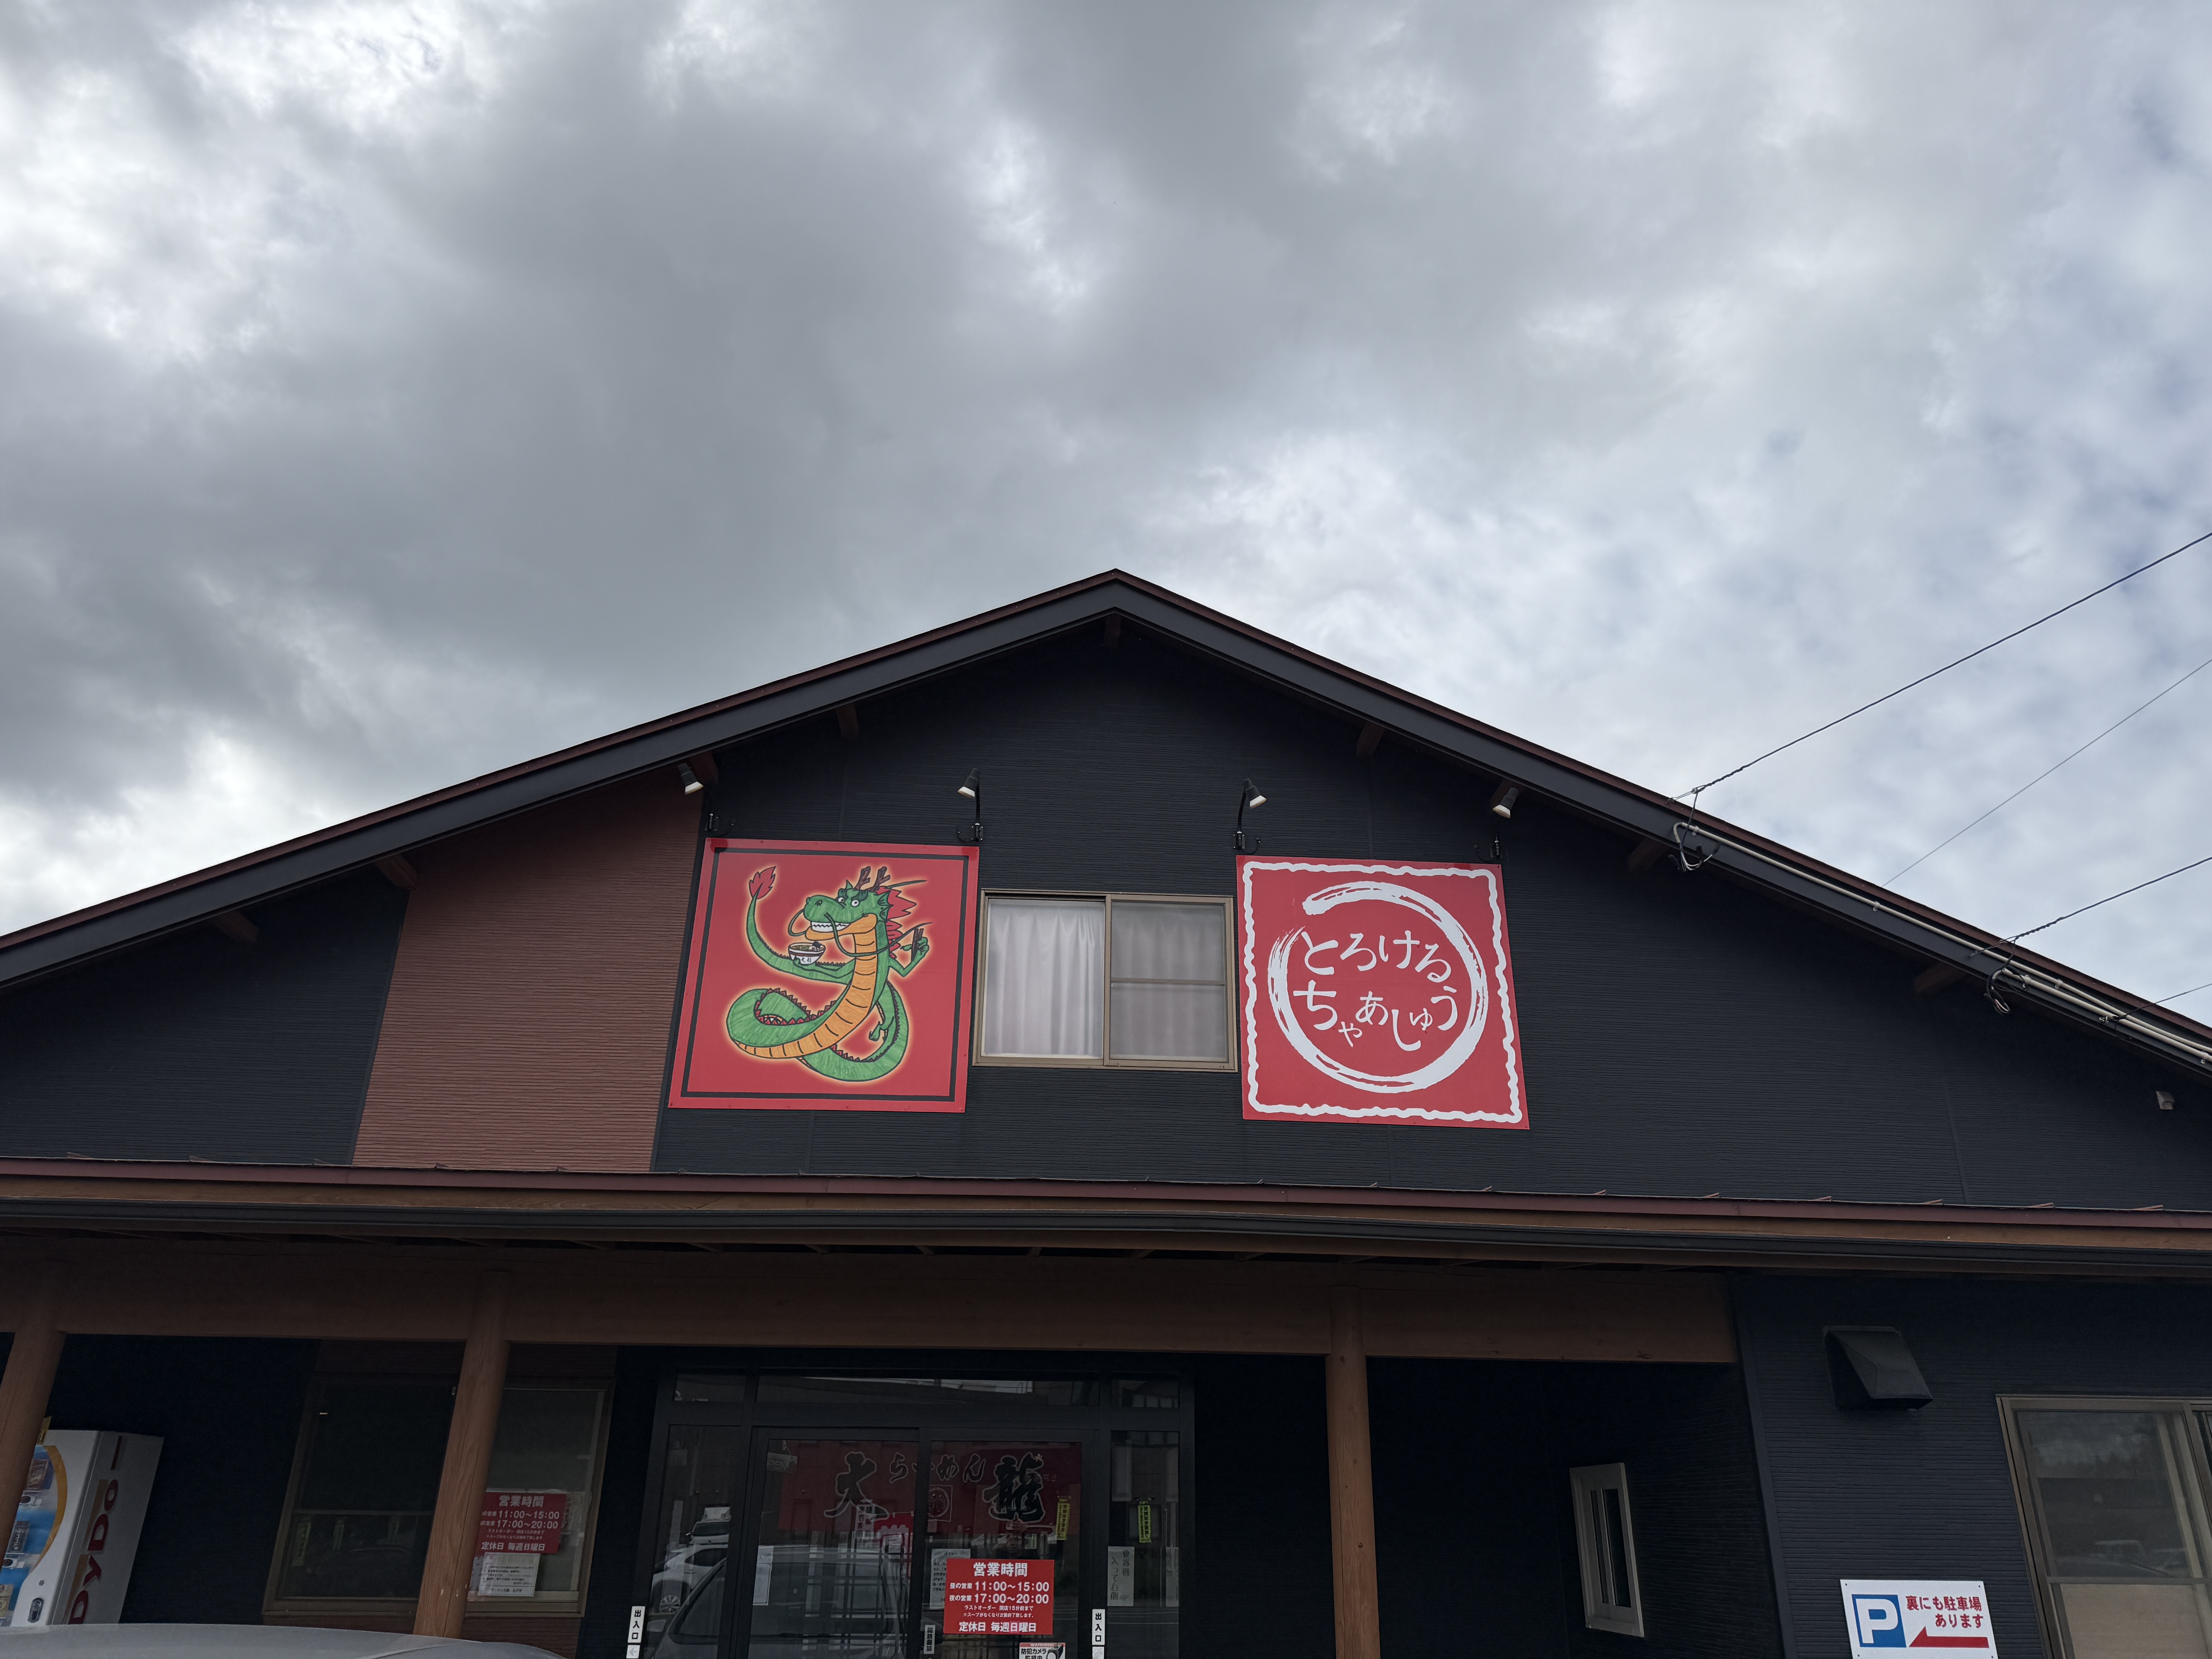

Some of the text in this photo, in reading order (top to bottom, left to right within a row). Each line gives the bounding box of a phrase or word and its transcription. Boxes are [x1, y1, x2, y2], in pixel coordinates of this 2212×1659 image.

[1302, 931, 1451, 983] とろける
[1293, 980, 1458, 1051] ちゃあしゅう
[499, 1495, 544, 1508] 営業時間
[481, 1542, 545, 1551] 定休日 毎週日曜日
[973, 1562, 1028, 1577] 営業時間
[1905, 1595, 1982, 1612] 裏にも駐車場
[632, 1609, 641, 1639] 出入口
[959, 1621, 1037, 1632] 定休日 毎週日曜日
[1855, 1598, 1898, 1644] P
[1934, 1613, 1984, 1629] あります
